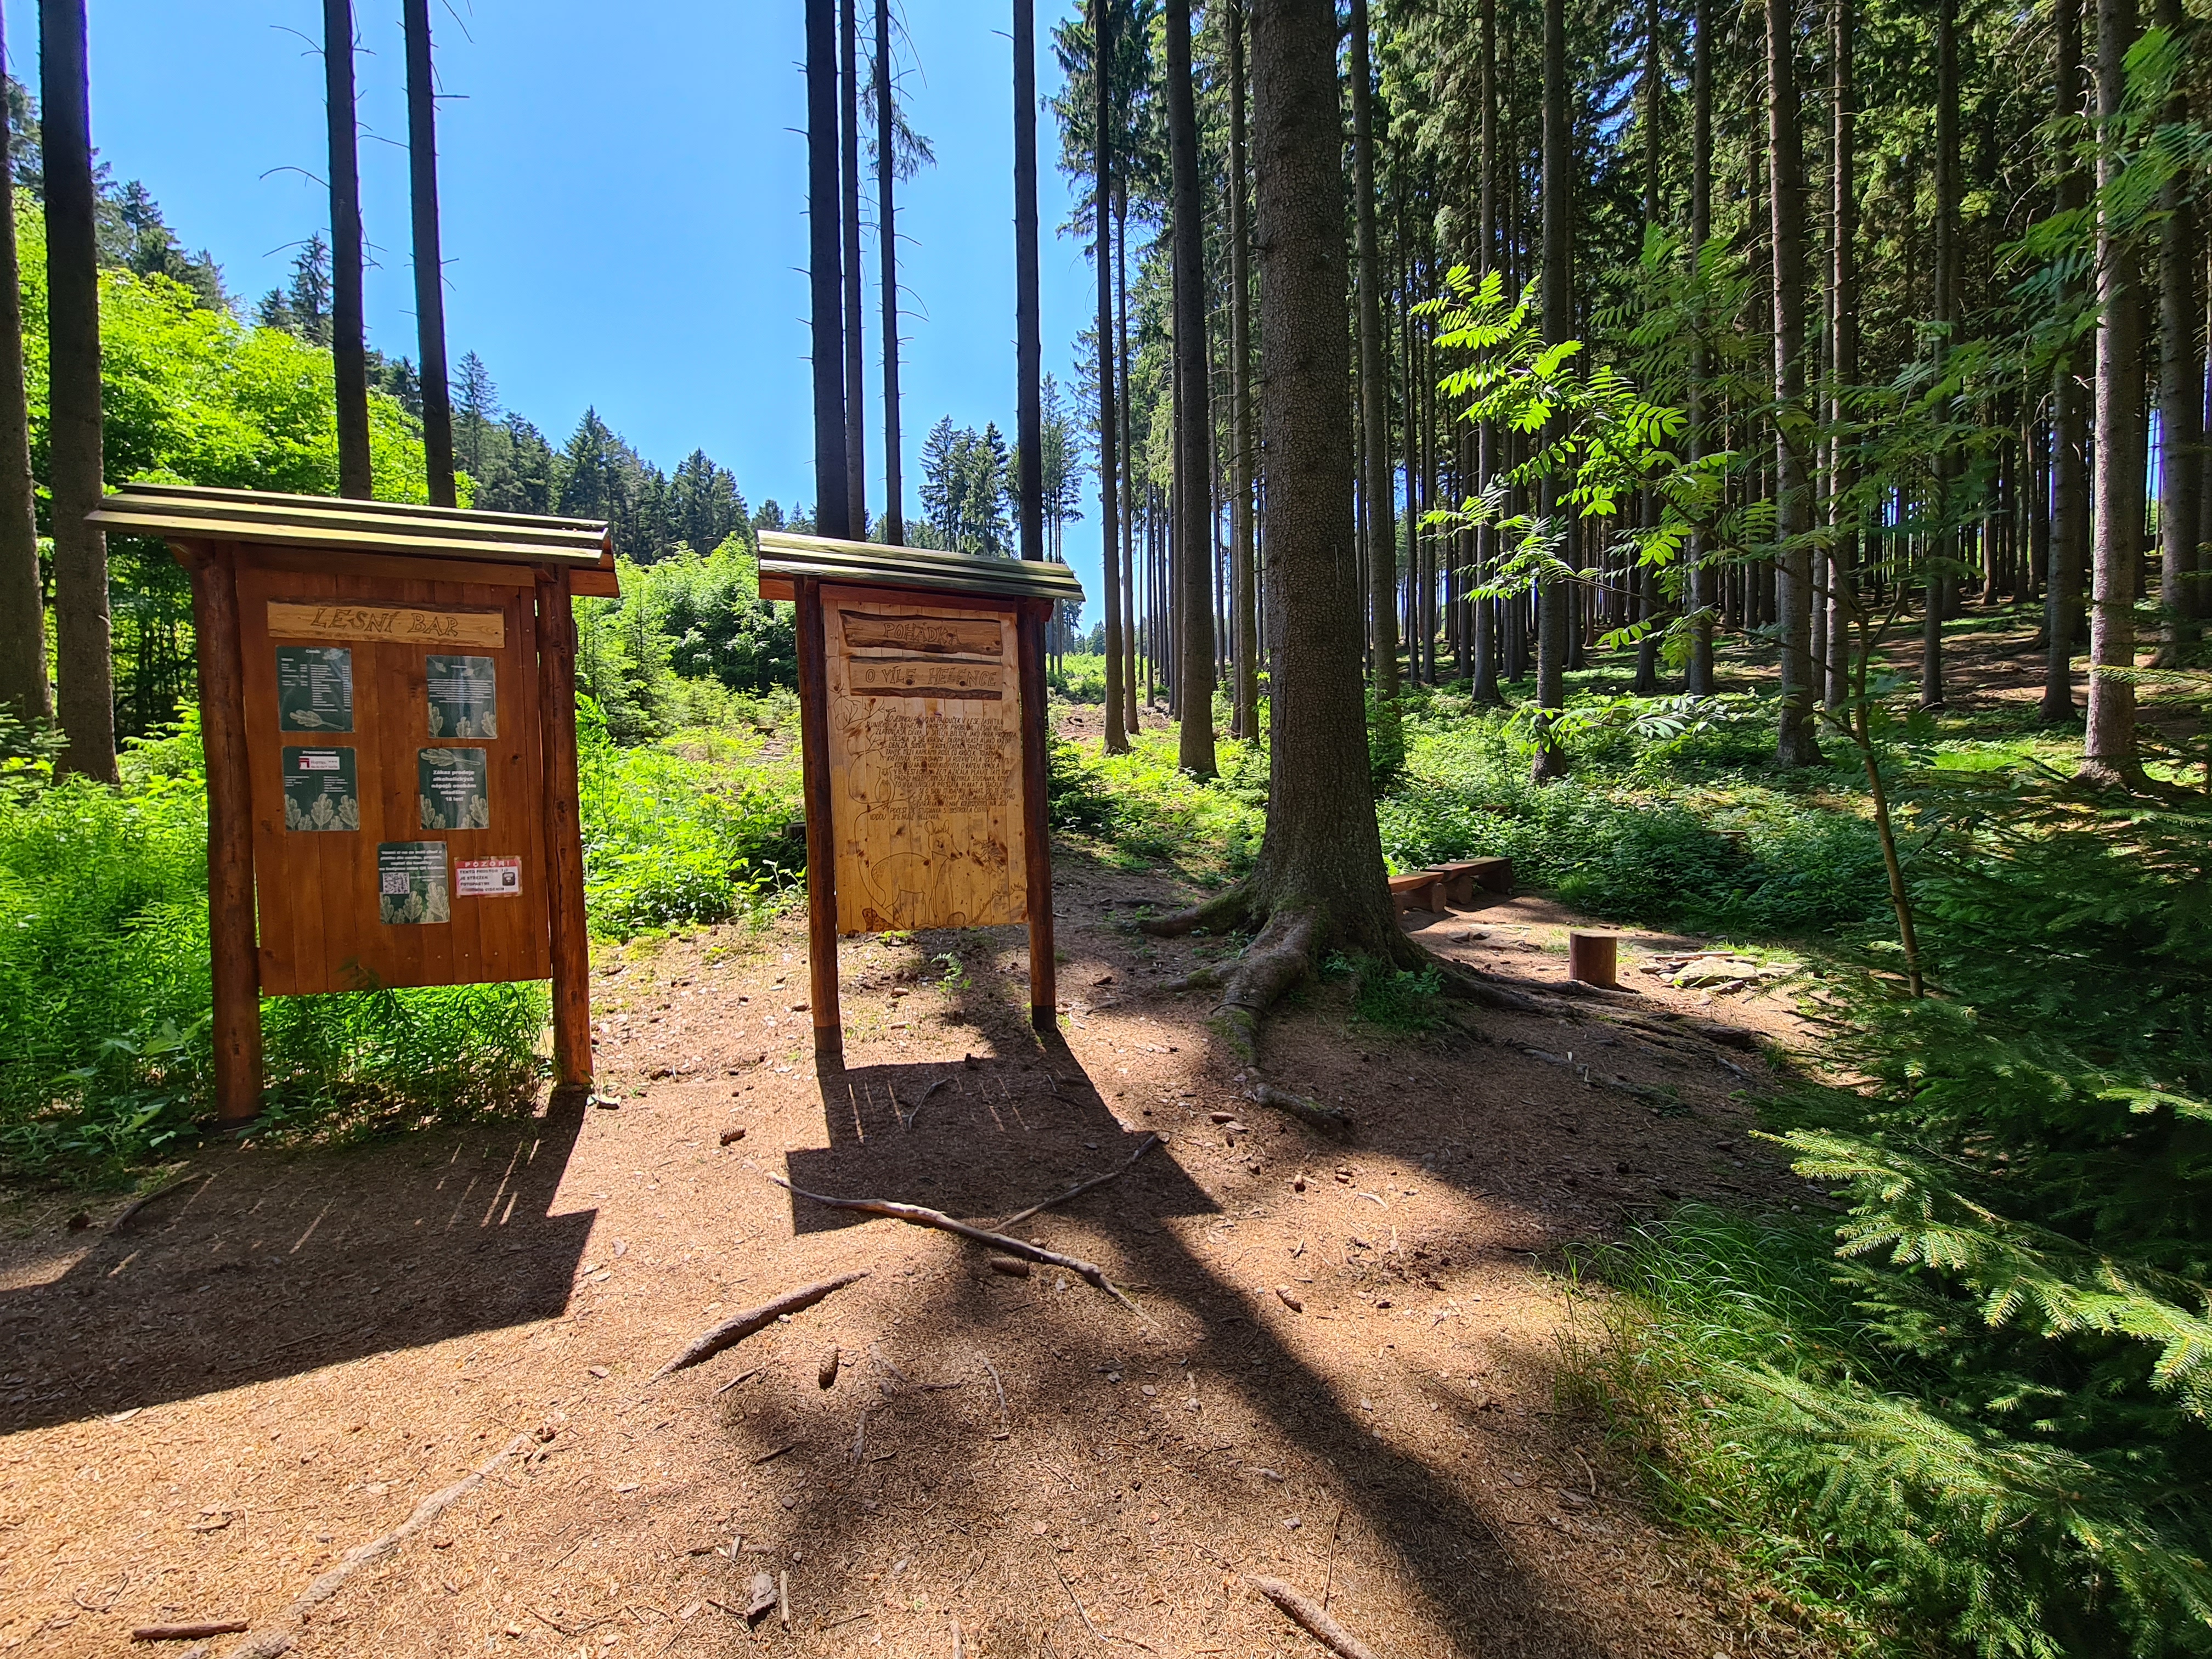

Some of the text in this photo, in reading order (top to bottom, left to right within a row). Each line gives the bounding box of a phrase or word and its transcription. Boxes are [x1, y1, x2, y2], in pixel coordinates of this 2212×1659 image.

[311, 607, 458, 637] LESNÍ BAR
[883, 622, 961, 645] POHÁDKA
[865, 665, 997, 687] O VÍLE HELENCE
